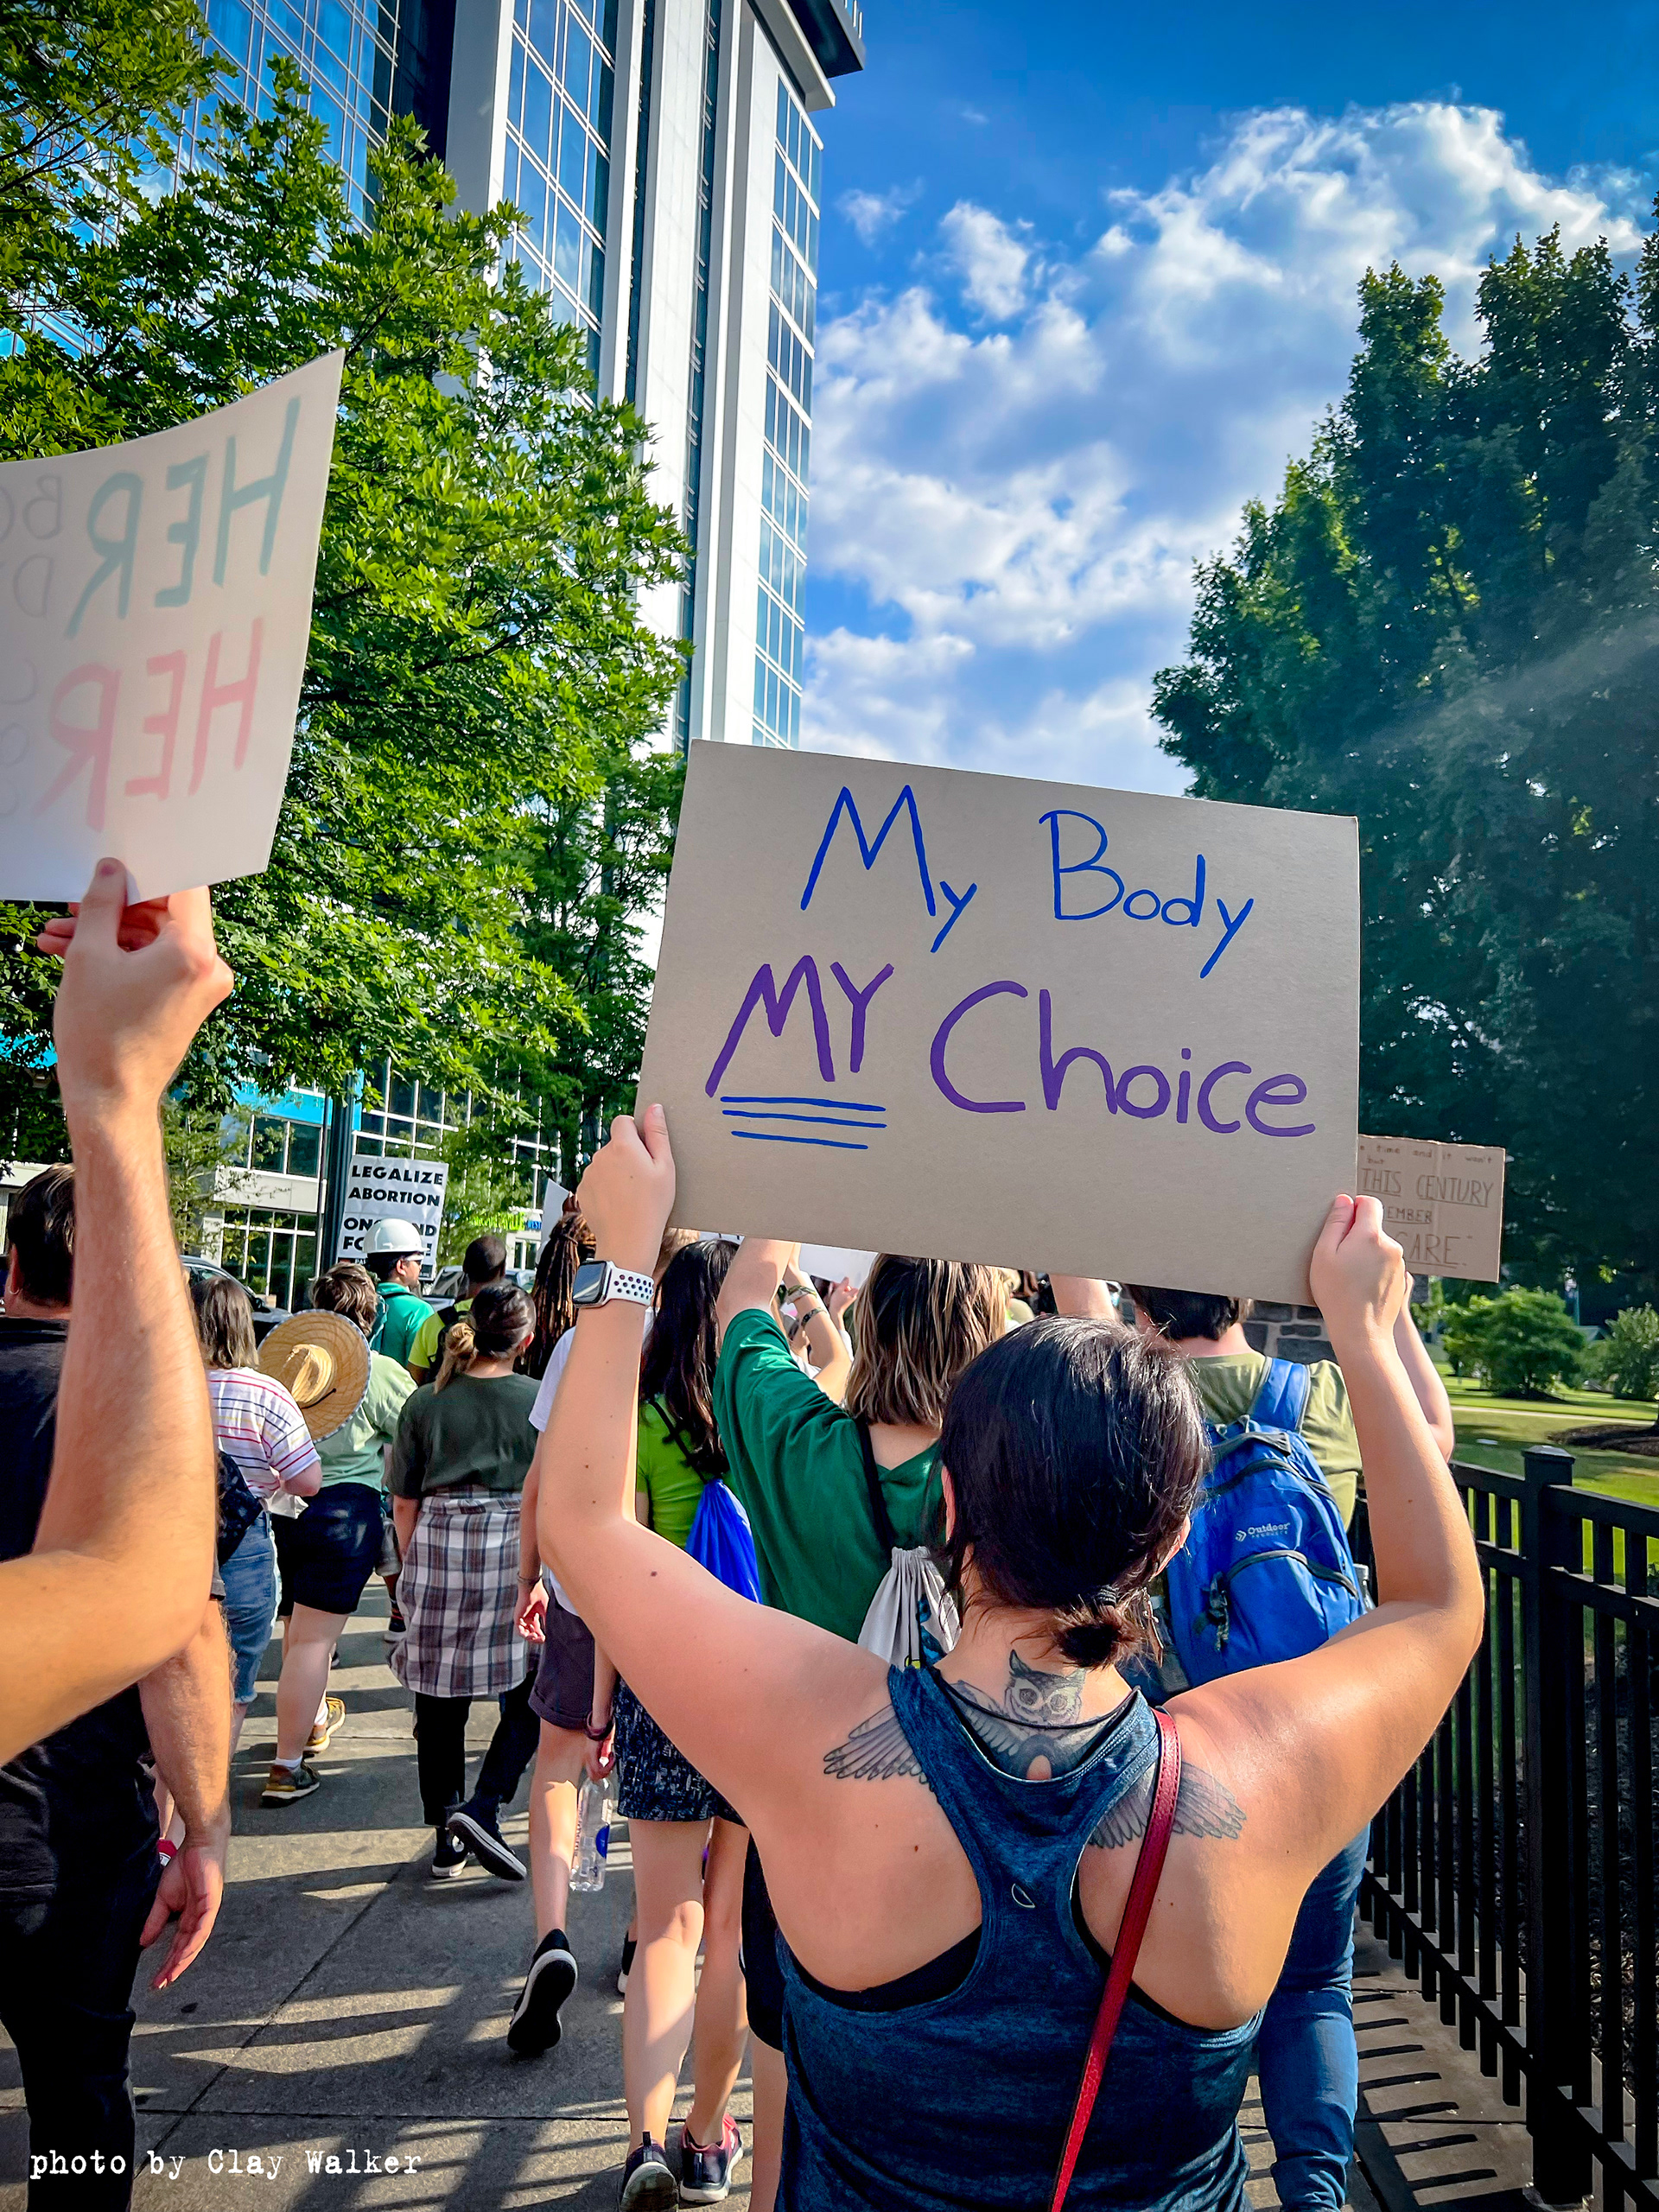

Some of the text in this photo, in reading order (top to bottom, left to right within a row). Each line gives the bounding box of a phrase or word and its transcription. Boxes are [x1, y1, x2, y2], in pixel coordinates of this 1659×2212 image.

[800, 784, 1254, 979] My Body
[705, 954, 1317, 1137] MY Choice
[352, 1165, 443, 1185] LEGALIZE
[1361, 1168, 1494, 1205] THIS CENTURY
[348, 1187, 440, 1206] ABORTION
[1385, 1206, 1433, 1224] EMBER
[344, 1217, 437, 1236] ON ND
[343, 1236, 365, 1251] FO
[1248, 1522, 1291, 1535] Outdoor
